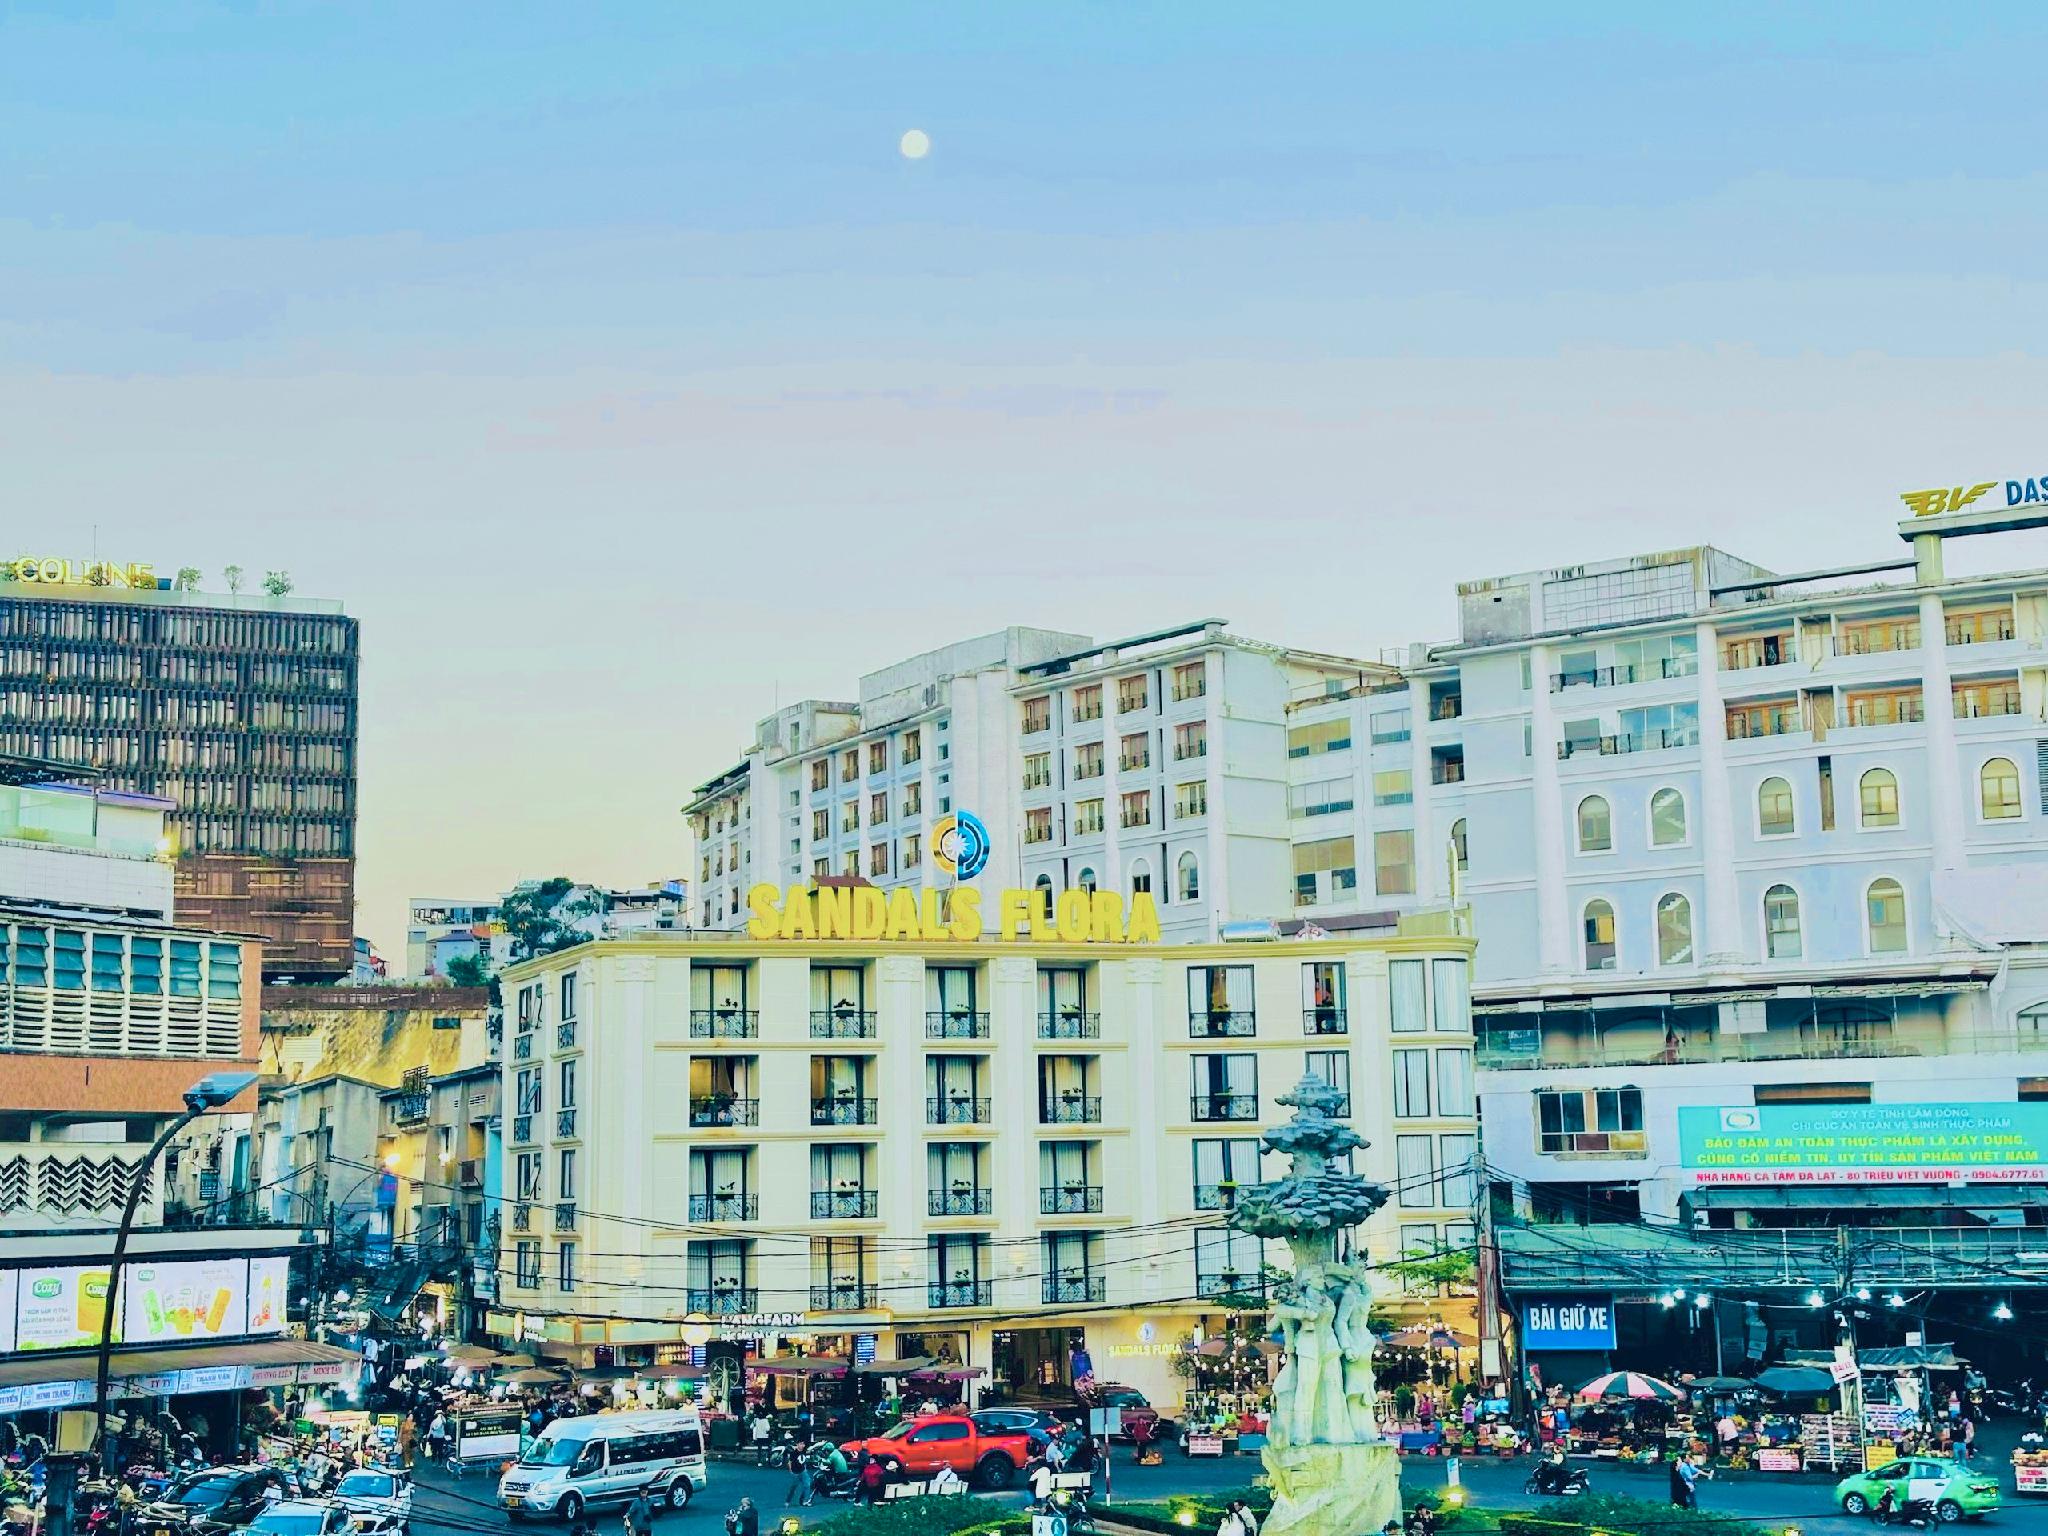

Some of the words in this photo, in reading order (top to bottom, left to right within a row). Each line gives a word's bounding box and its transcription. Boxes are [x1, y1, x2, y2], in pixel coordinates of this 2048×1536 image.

[747, 883, 983, 942] SANDALS
[999, 888, 1161, 943] FLORA
[1840, 1120, 1857, 1130] AN
[1912, 1119, 1939, 1130] SINH
[1774, 1138, 1793, 1147] AN
[1837, 1152, 1856, 1162] UY
[2005, 1150, 2038, 1160] NAM
[35, 1280, 60, 1296] Cozy
[1530, 1303, 1556, 1331] BÃI
[1559, 1302, 1587, 1331] GIỮ
[1588, 1307, 1609, 1331] XE
[1109, 1344, 1151, 1357] SANDALS
[1152, 1343, 1183, 1355] FLORA
